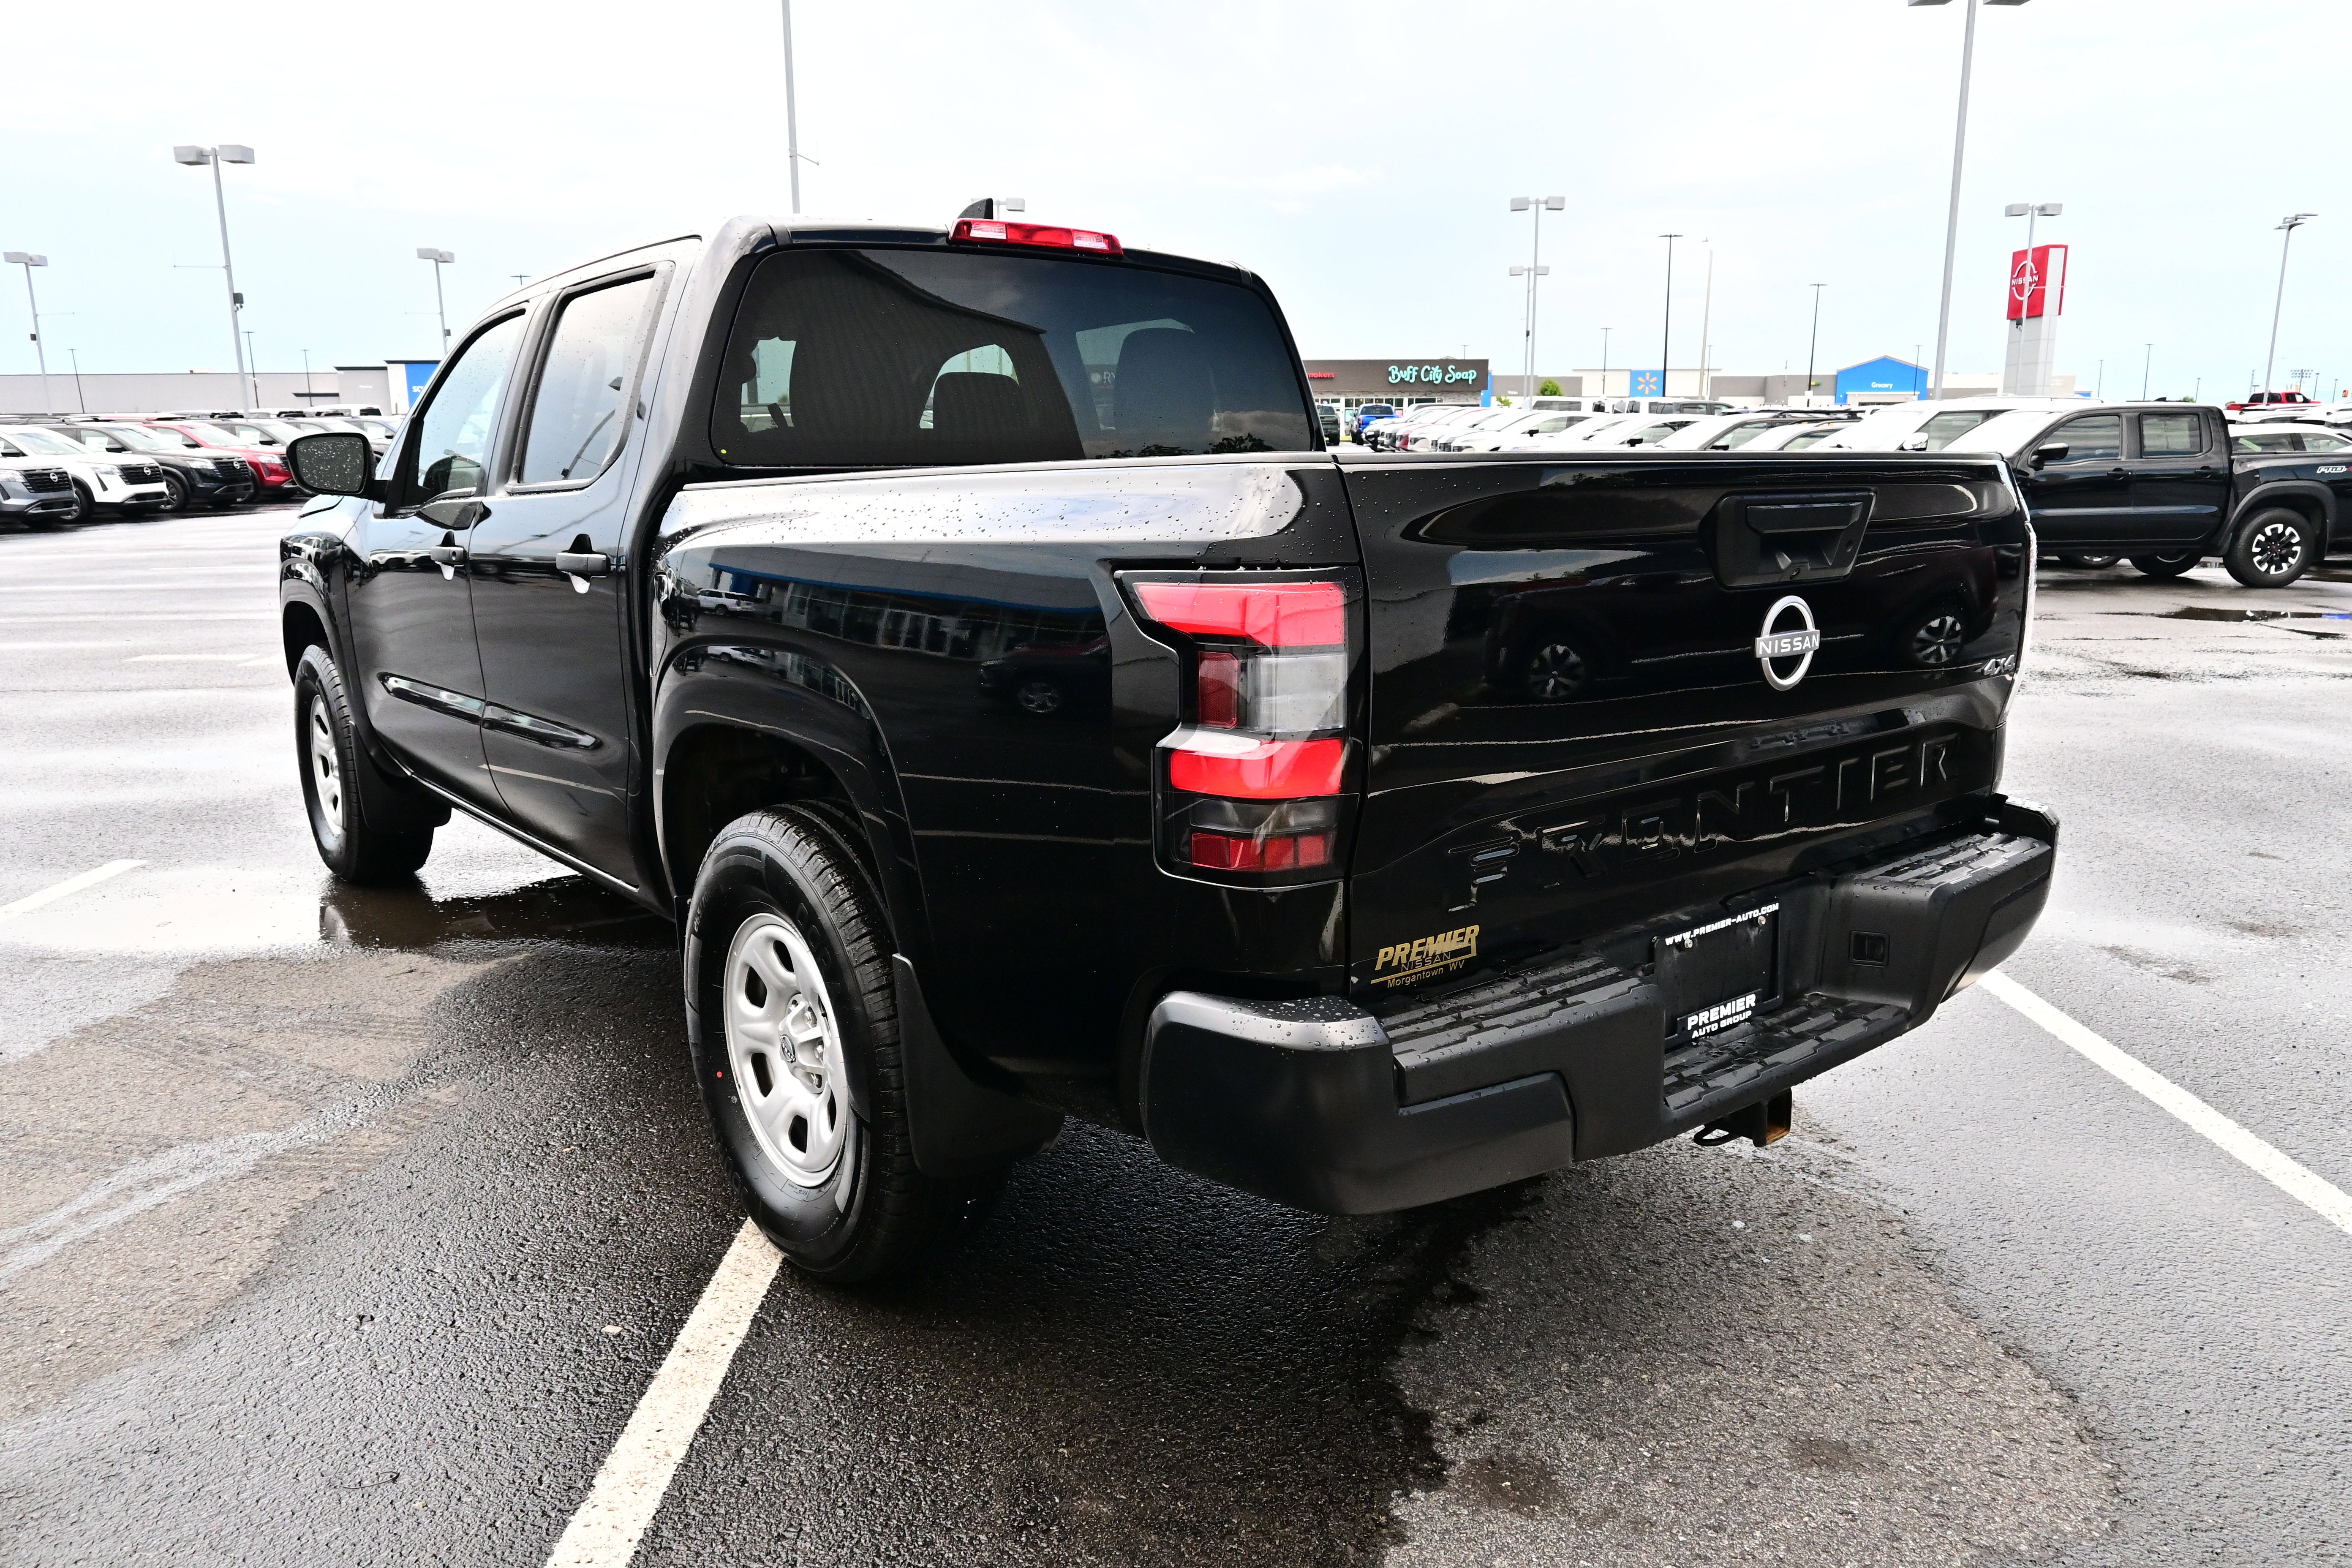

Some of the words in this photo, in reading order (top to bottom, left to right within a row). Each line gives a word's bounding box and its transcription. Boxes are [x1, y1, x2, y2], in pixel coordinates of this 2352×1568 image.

[1388, 365, 1419, 383] Buff
[1421, 365, 1443, 384] City
[1445, 365, 1477, 384] Soap
[1759, 634, 1819, 654] NISSAN
[1984, 654, 2015, 676] 4X4
[1446, 732, 1961, 913] FRONTIER
[1665, 902, 1779, 946] WWW.PREMIER-AUTO.COM
[1375, 925, 1480, 971] PREMIER
[1401, 951, 1451, 972] NISSAN
[1387, 967, 1444, 988] Morgantown
[1449, 960, 1465, 971] WV
[1687, 994, 1756, 1031] PREMIER
[1692, 1023, 1718, 1039] AUTO
[1720, 1010, 1752, 1028] GROUP
